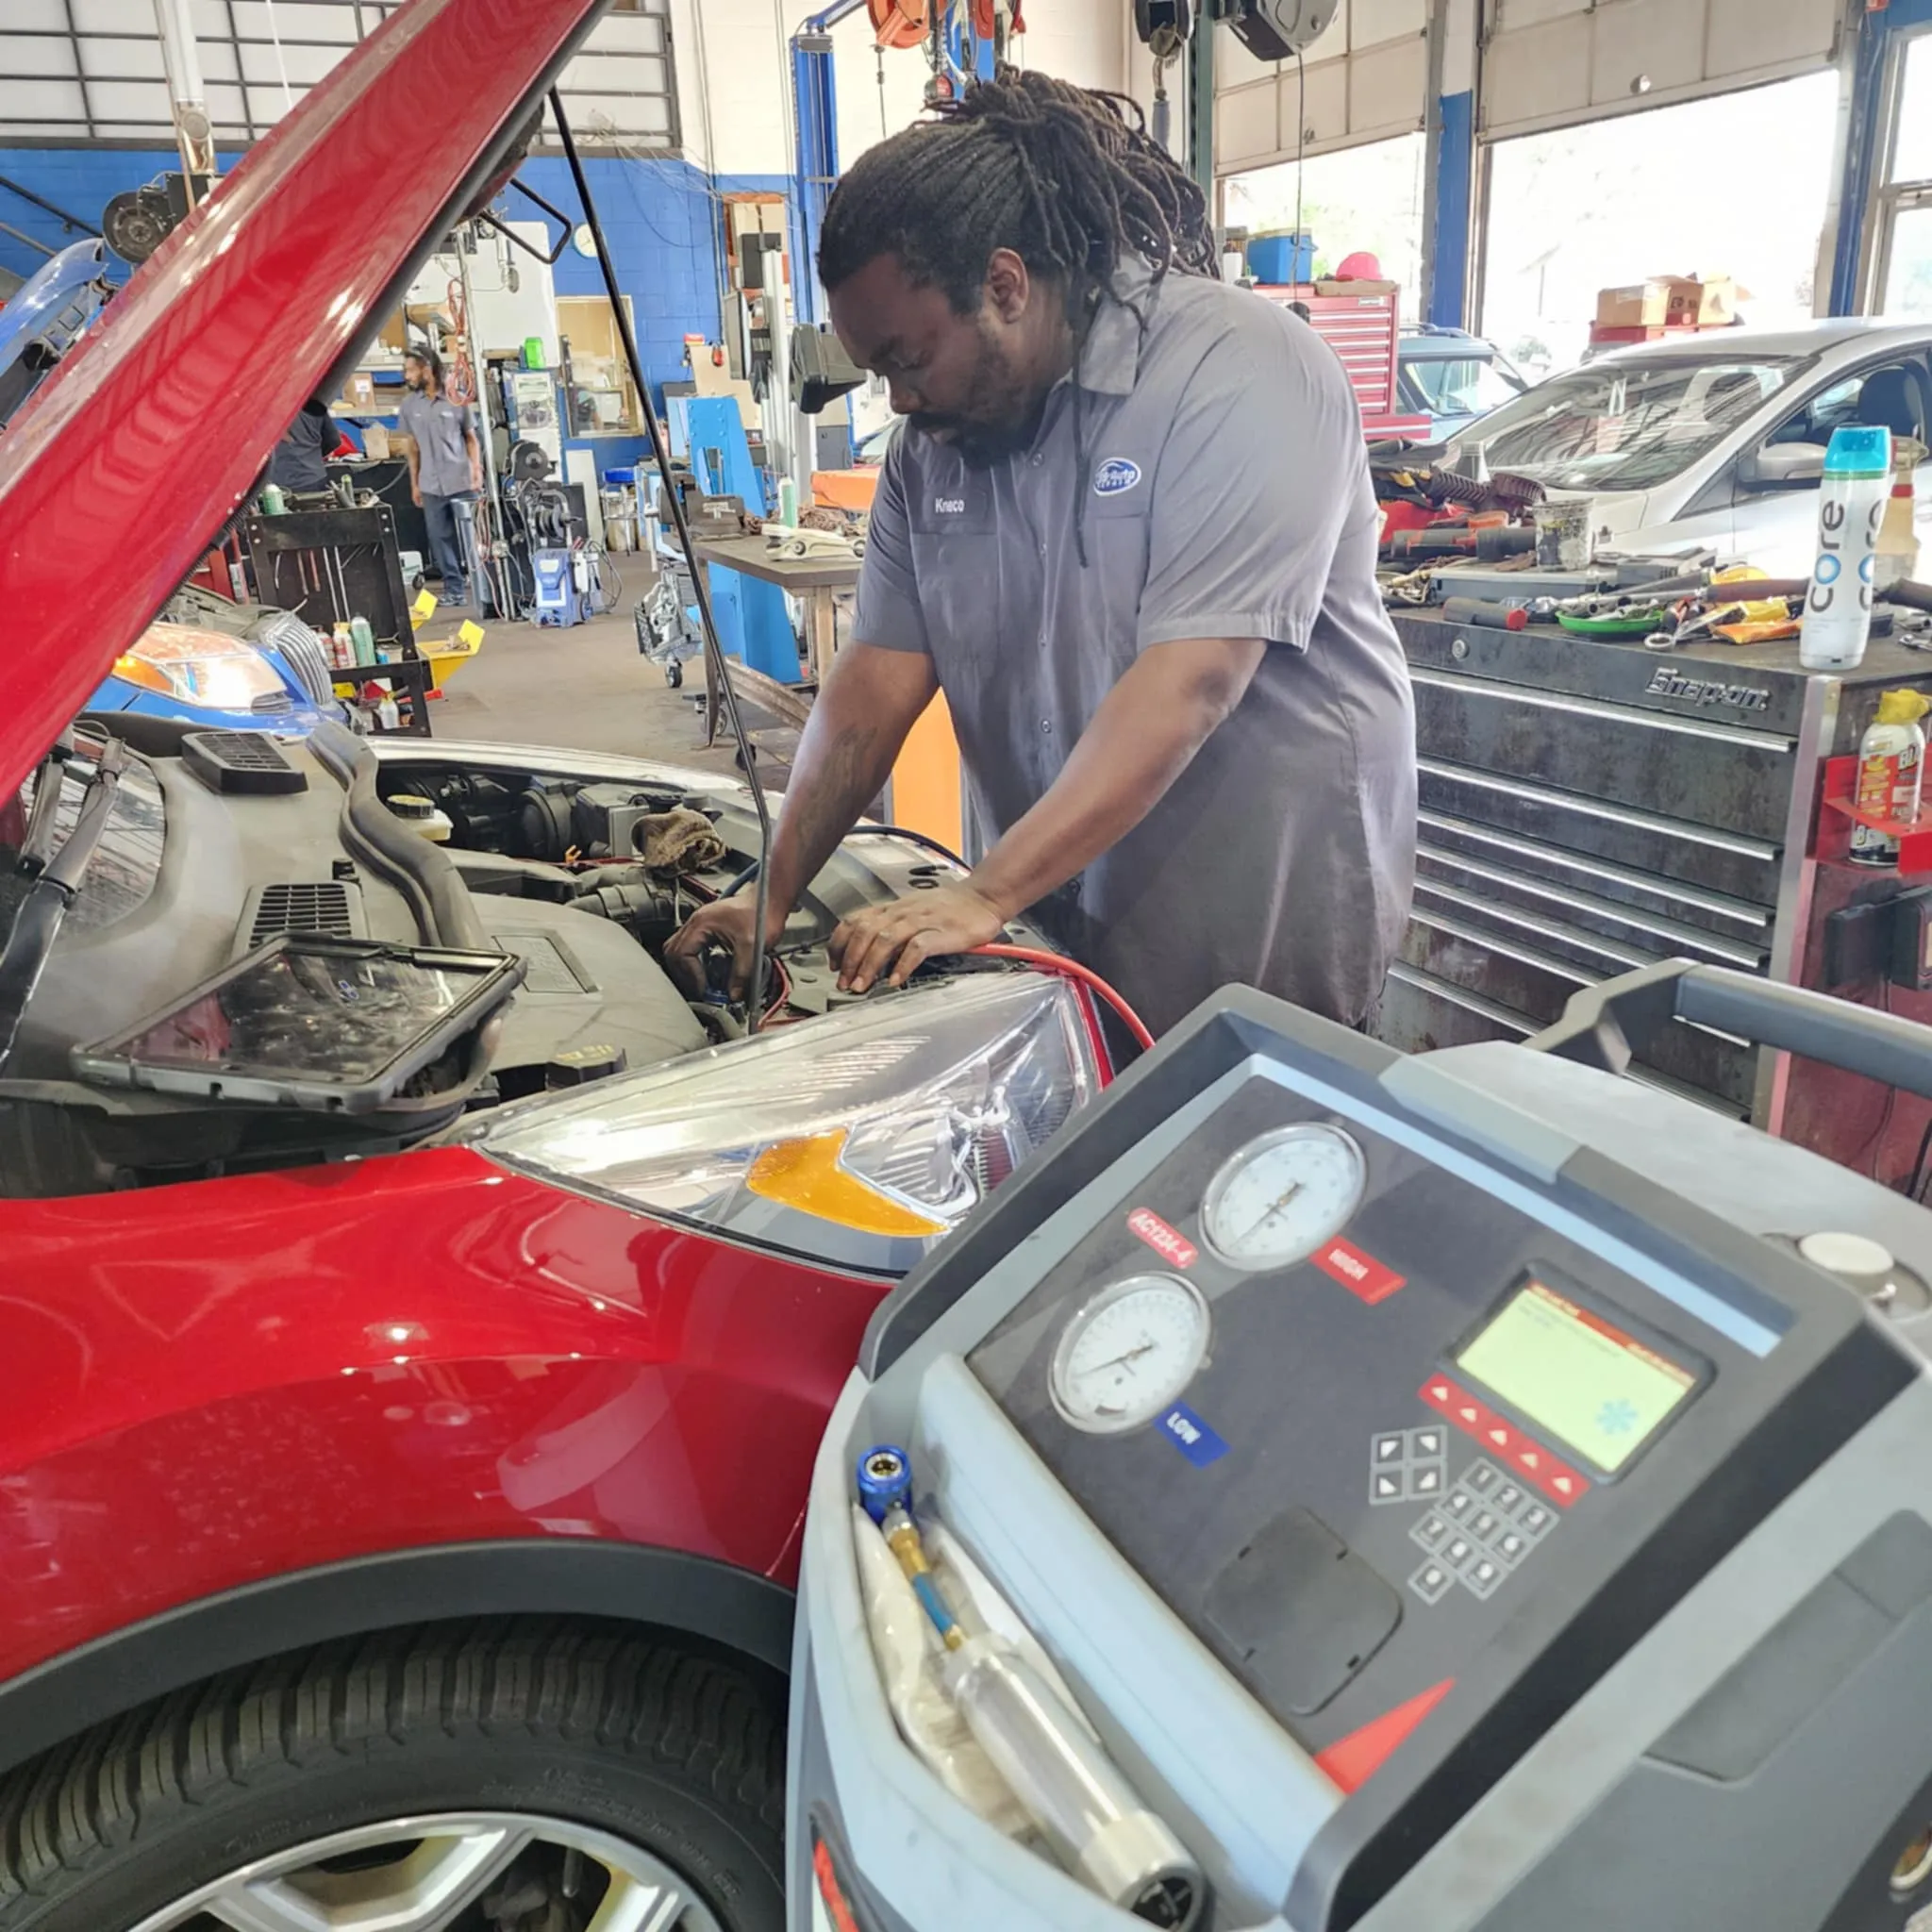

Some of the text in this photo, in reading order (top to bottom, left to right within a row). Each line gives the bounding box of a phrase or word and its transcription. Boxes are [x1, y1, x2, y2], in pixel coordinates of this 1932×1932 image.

[1809, 499, 1845, 612] core
[1167, 1411, 1201, 1445] LOW
[1502, 1488, 1518, 1503] 2
[1528, 1509, 1545, 1525] 3
[1428, 1520, 1443, 1534] 7
